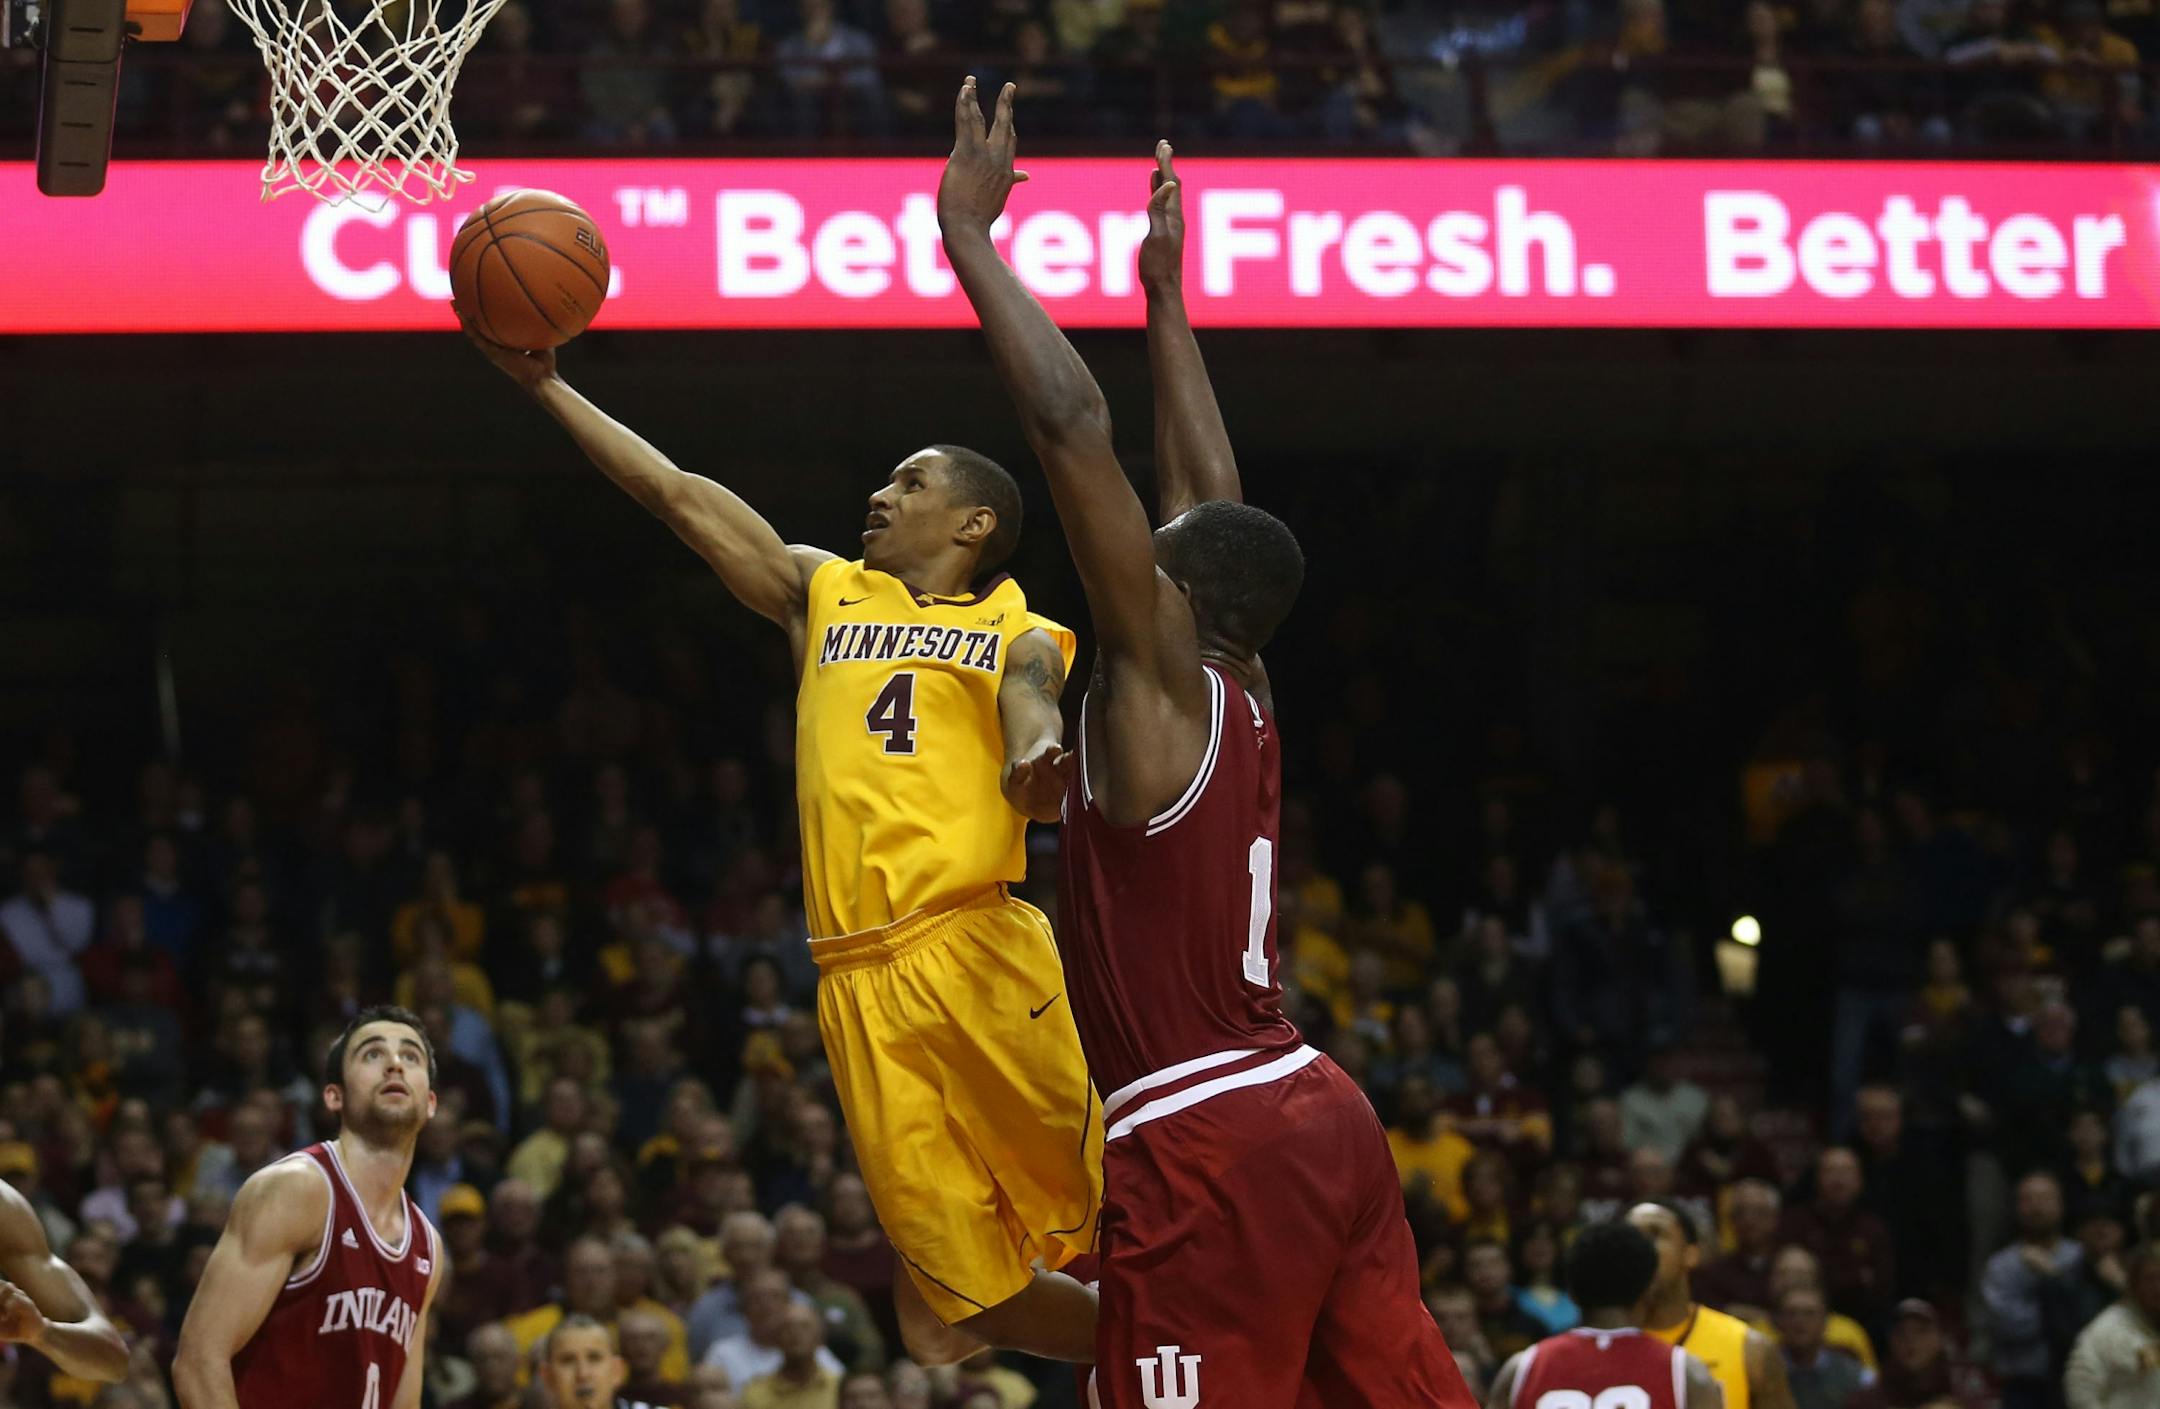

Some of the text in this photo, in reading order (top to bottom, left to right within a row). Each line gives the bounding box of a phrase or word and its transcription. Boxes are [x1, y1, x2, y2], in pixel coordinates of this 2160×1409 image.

[715, 189, 1155, 299] Beter
[1200, 184, 1617, 299] Fresh.
[1704, 189, 2127, 299] Better
[818, 622, 1001, 674] MINNESOTA
[865, 671, 918, 756] 4
[1242, 836, 1272, 988] 1
[317, 1286, 417, 1354] INDIAN
